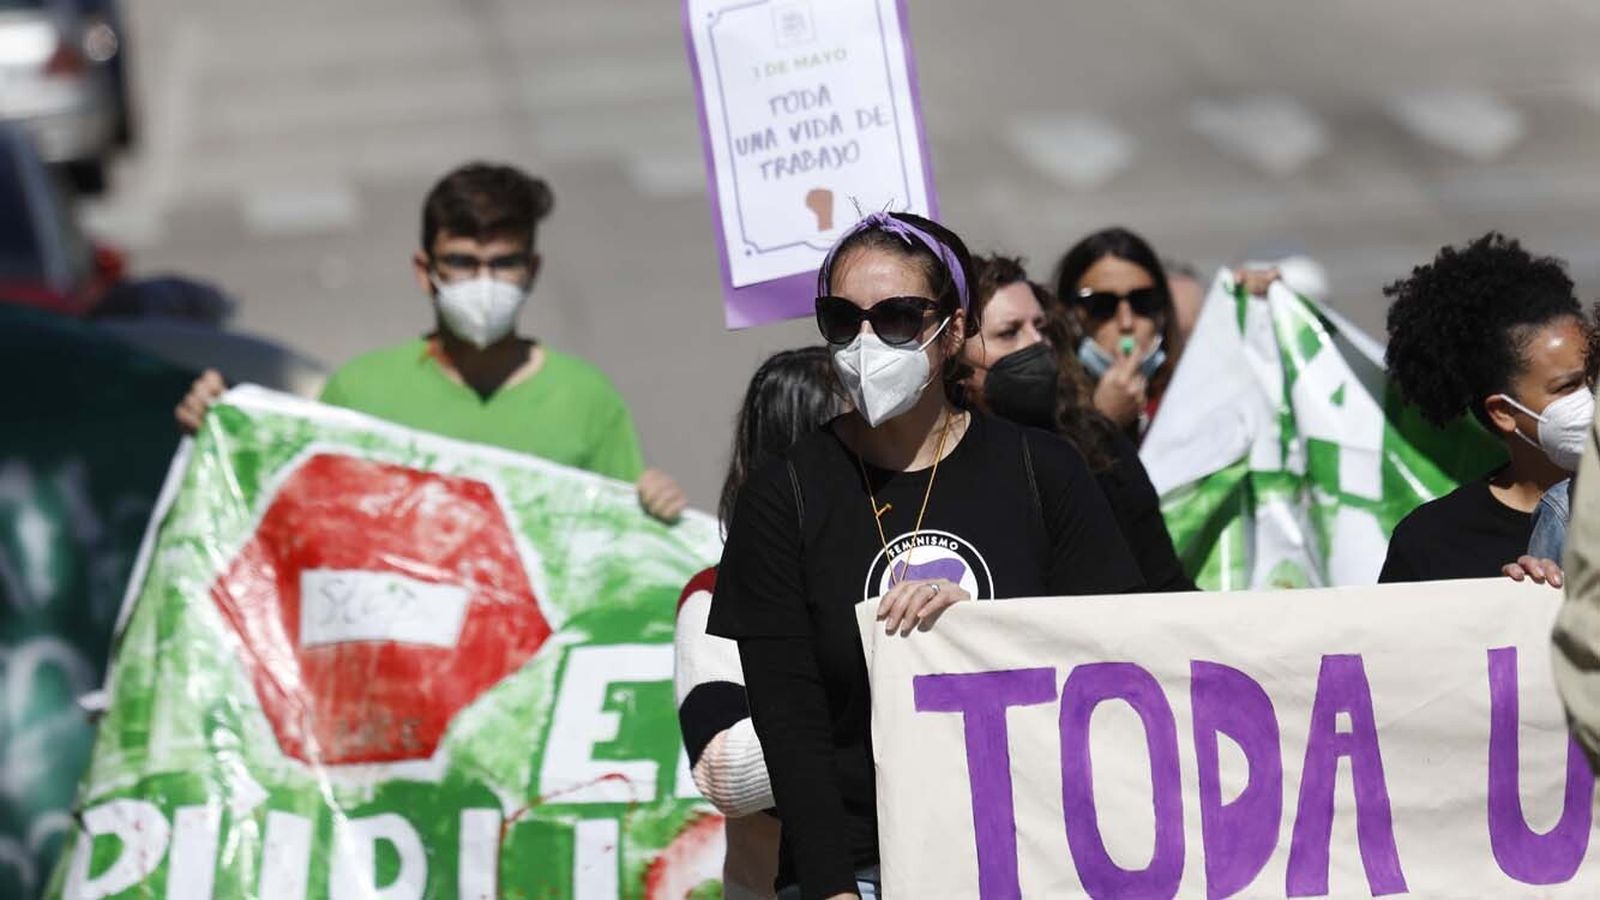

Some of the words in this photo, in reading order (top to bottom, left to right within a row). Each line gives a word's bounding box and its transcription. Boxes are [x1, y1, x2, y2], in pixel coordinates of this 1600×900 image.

[764, 59, 790, 78] DE
[793, 47, 848, 69] MAYO
[768, 84, 832, 116] TODA
[735, 127, 778, 156] UNA
[789, 112, 844, 144] VIDA
[855, 105, 891, 130] DE
[760, 139, 860, 181] TRABAJO
[889, 535, 959, 558] FEMINISMO
[912, 652, 1409, 900] TODA
